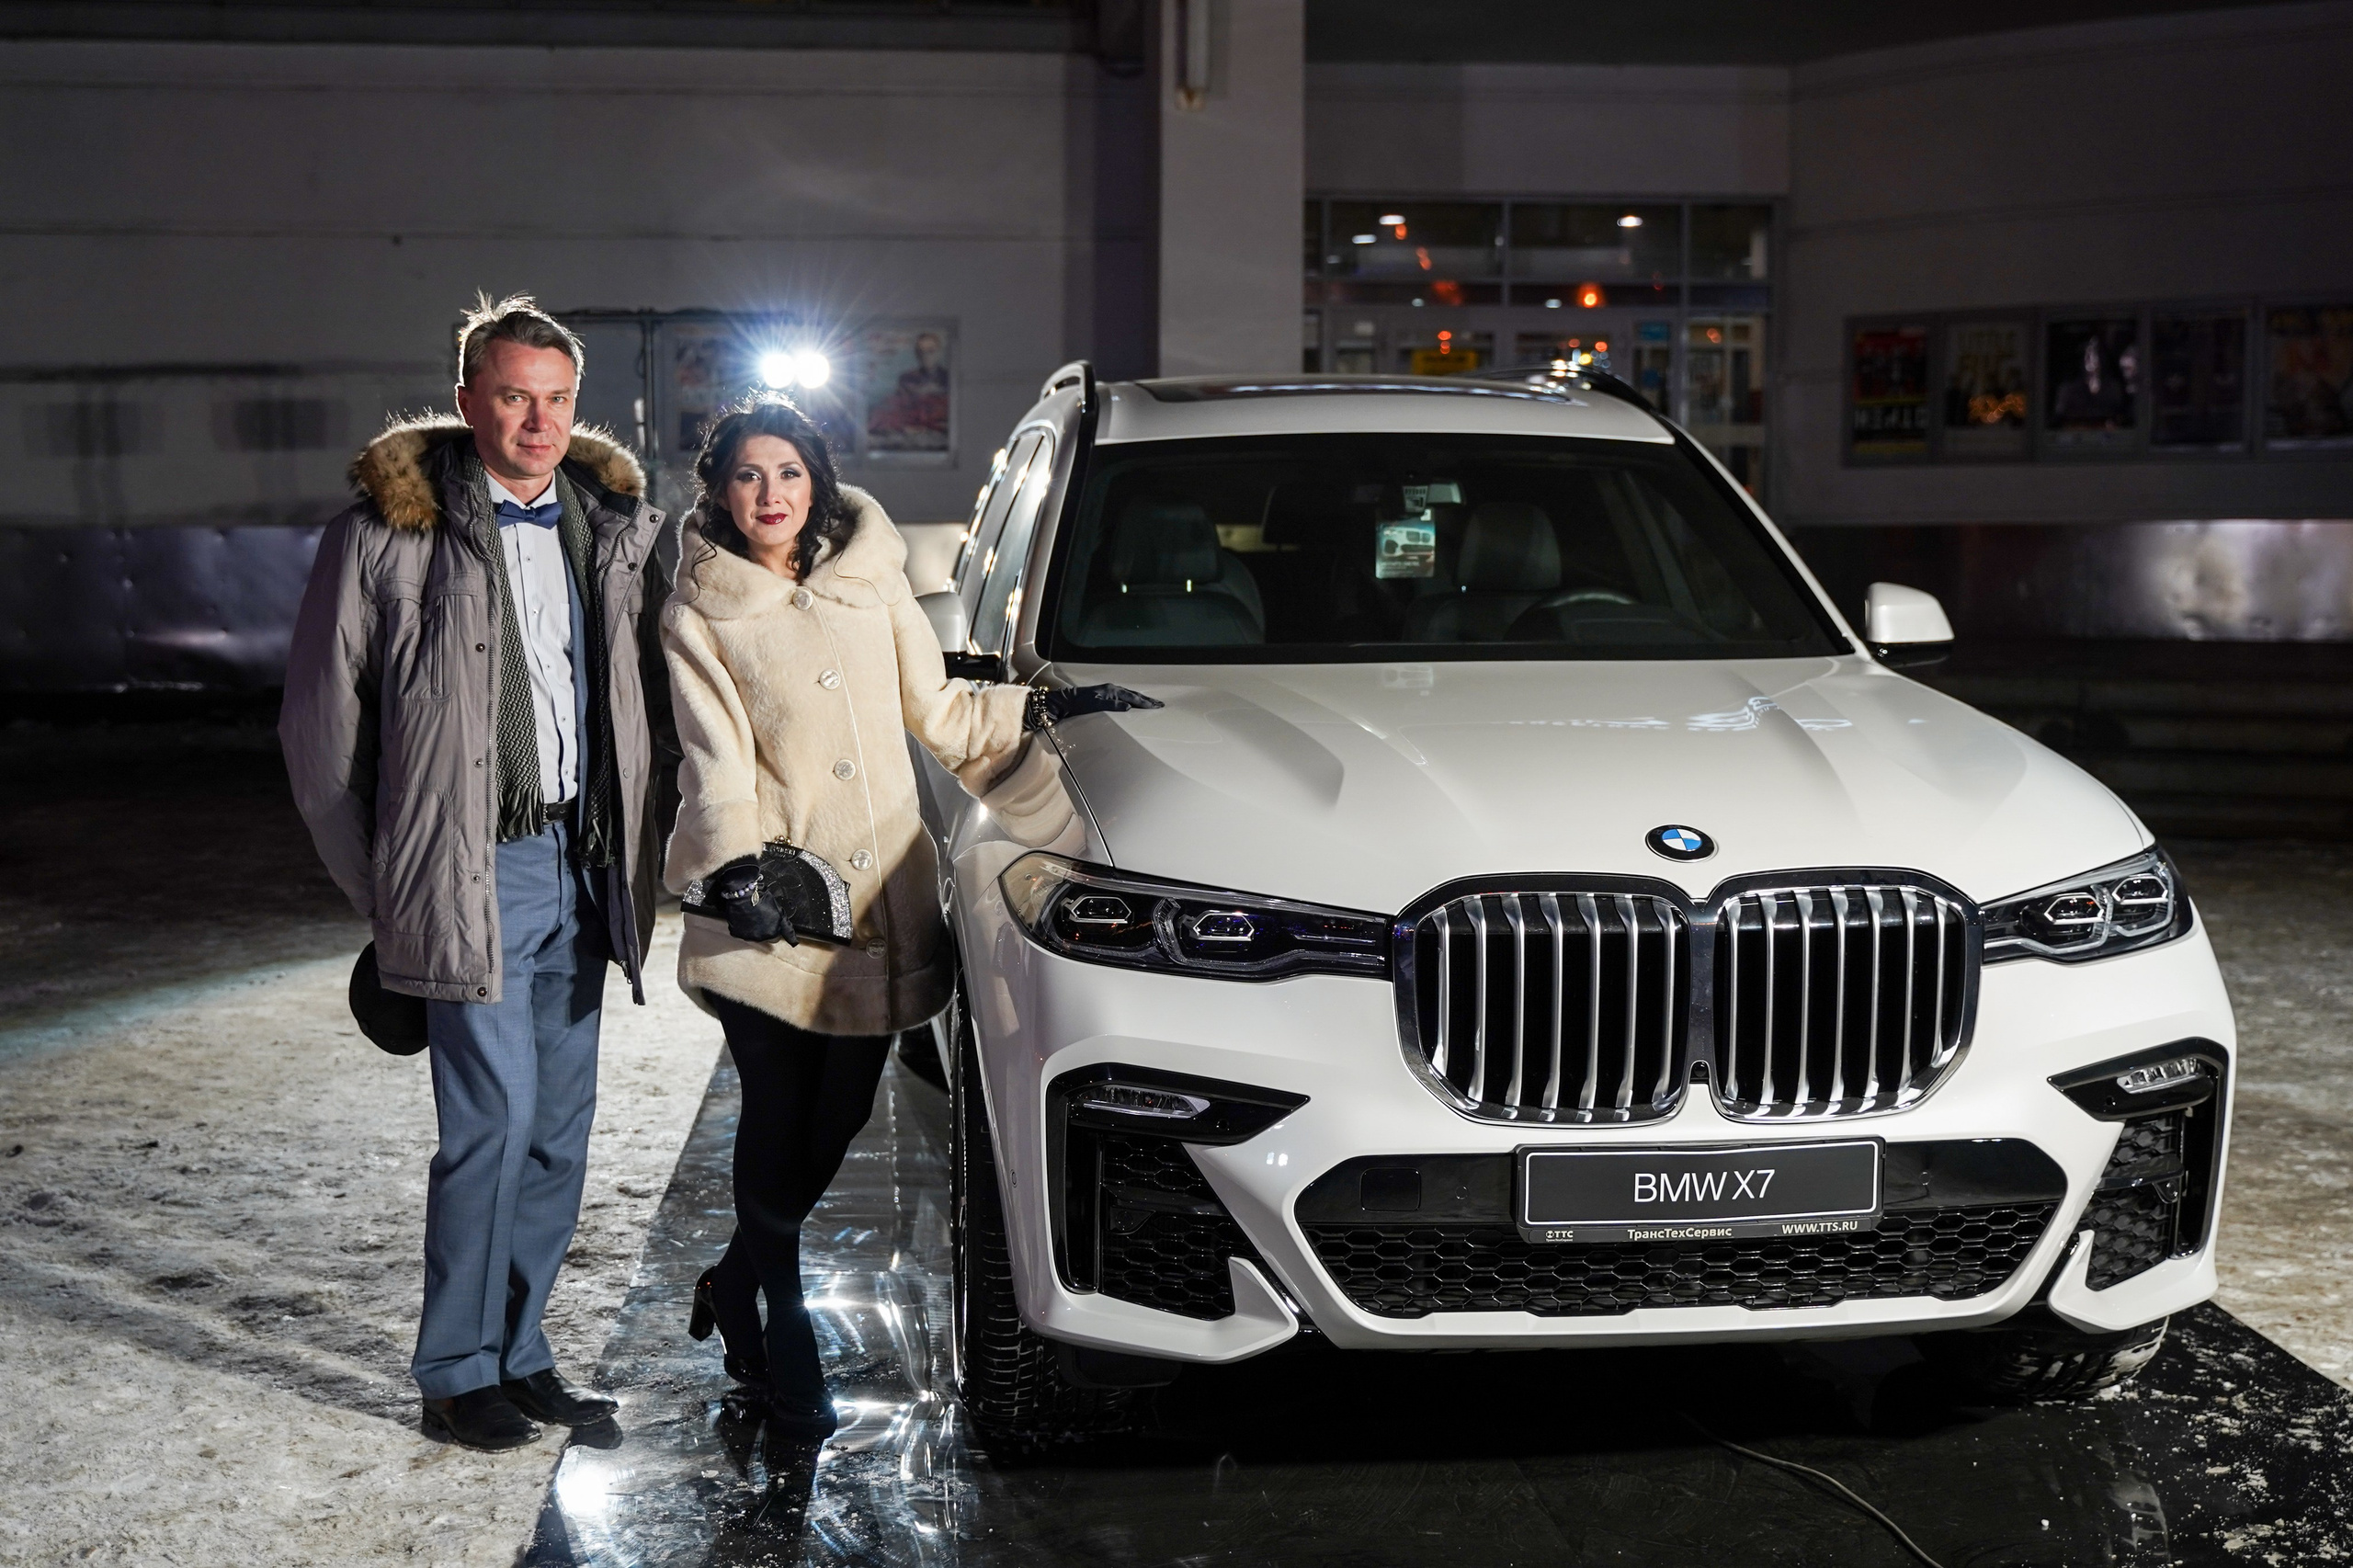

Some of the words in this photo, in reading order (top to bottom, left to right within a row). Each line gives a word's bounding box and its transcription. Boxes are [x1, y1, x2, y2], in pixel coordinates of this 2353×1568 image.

[1633, 1172, 1728, 1203] BMW
[1731, 1168, 1776, 1200] X7
[1627, 1227, 1733, 1241] ТрансТехСервис
[1781, 1221, 1859, 1234] WWW.TTS.RU
